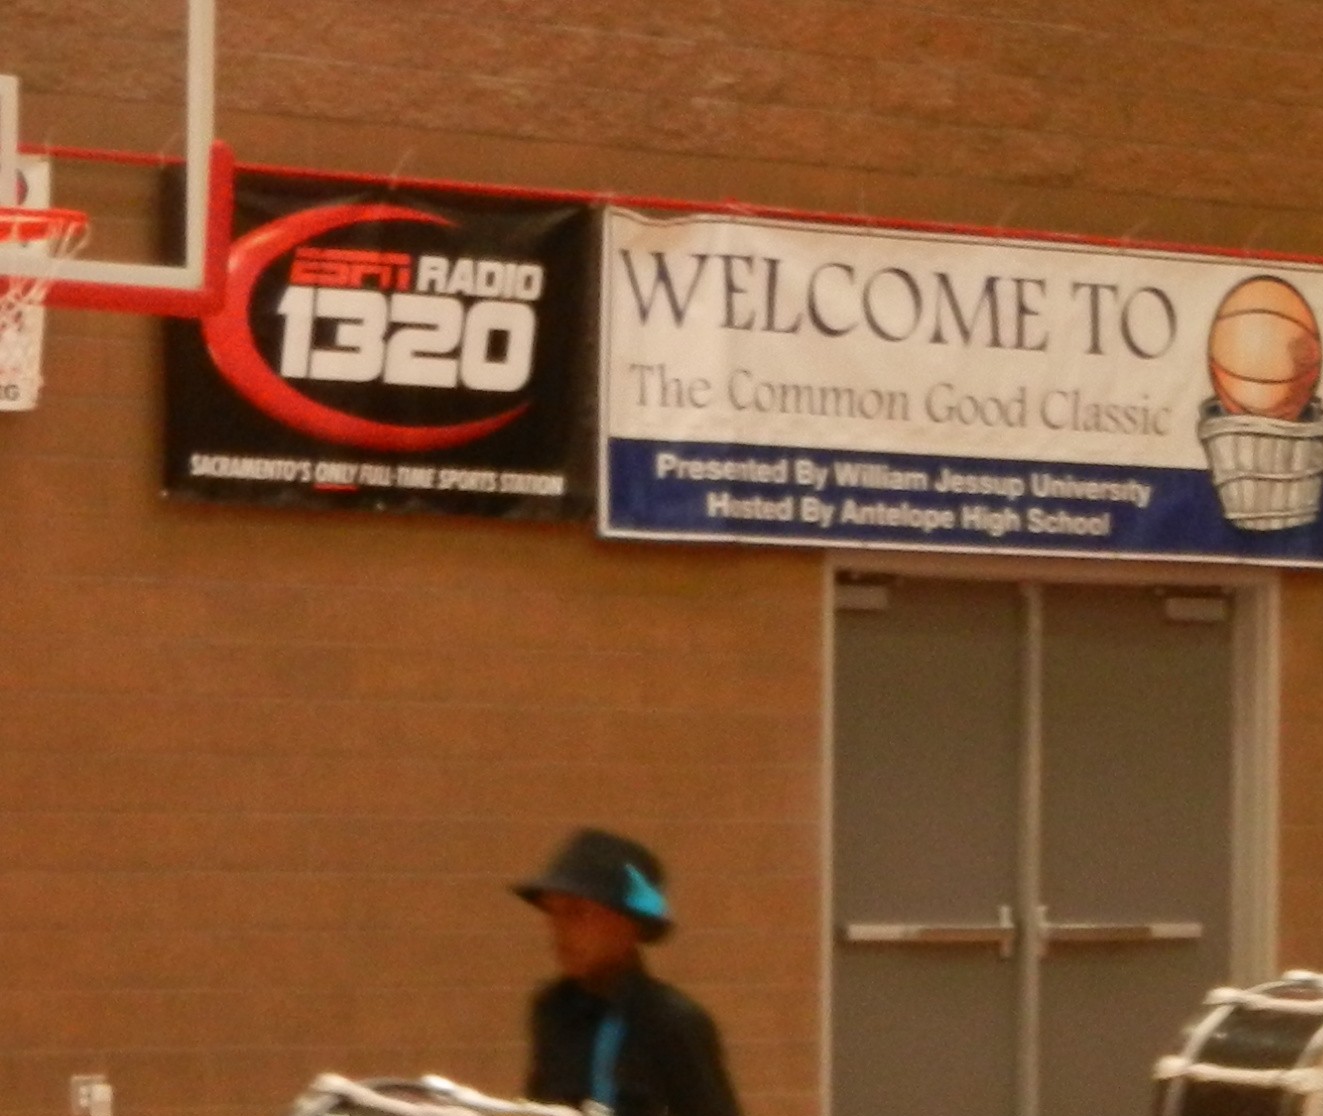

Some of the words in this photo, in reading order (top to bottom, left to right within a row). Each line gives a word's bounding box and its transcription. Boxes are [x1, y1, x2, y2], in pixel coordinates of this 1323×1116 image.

[289, 248, 412, 291] ESPN
[416, 256, 543, 300] RADIO
[620, 250, 1048, 353] WELCOME
[1074, 281, 1177, 360] TO
[277, 286, 536, 392] 1320
[629, 362, 711, 409] The
[727, 368, 909, 422] Common
[925, 382, 1027, 428] Good
[1040, 389, 1171, 437] Classic
[191, 454, 311, 482] SACRAMENTO'S
[315, 462, 357, 483] ONLY
[438, 468, 496, 492] SPORTS
[501, 472, 563, 496] STATION
[656, 453, 788, 485] Presented
[796, 460, 829, 490] By
[833, 461, 926, 490] William
[935, 468, 1023, 499] Jessup
[1032, 473, 1151, 508] University
[707, 492, 792, 521] Hosted
[801, 496, 834, 527] By
[840, 500, 955, 532] Antelope
[962, 505, 1020, 536] High
[1028, 510, 1112, 536] School
